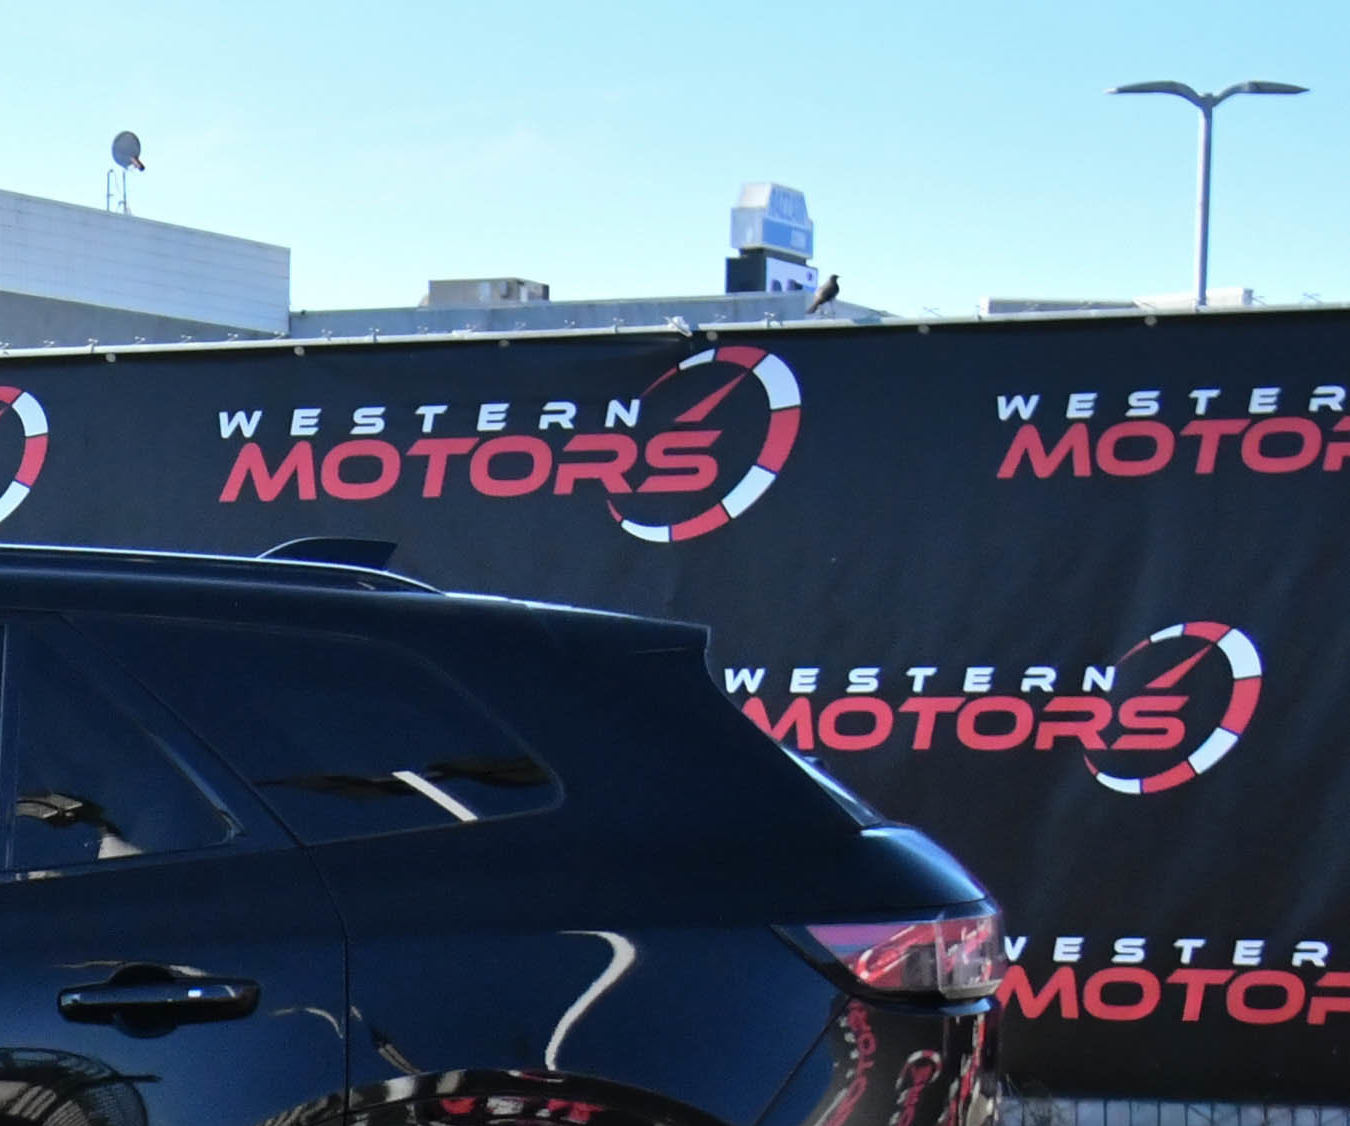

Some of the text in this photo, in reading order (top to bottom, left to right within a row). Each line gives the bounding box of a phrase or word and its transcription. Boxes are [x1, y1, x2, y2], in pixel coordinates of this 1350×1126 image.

[220, 400, 639, 438] WESTERN
[220, 432, 721, 501] MOTORS
[725, 667, 1115, 693] WESTERN
[741, 696, 1188, 750] MOTORS
